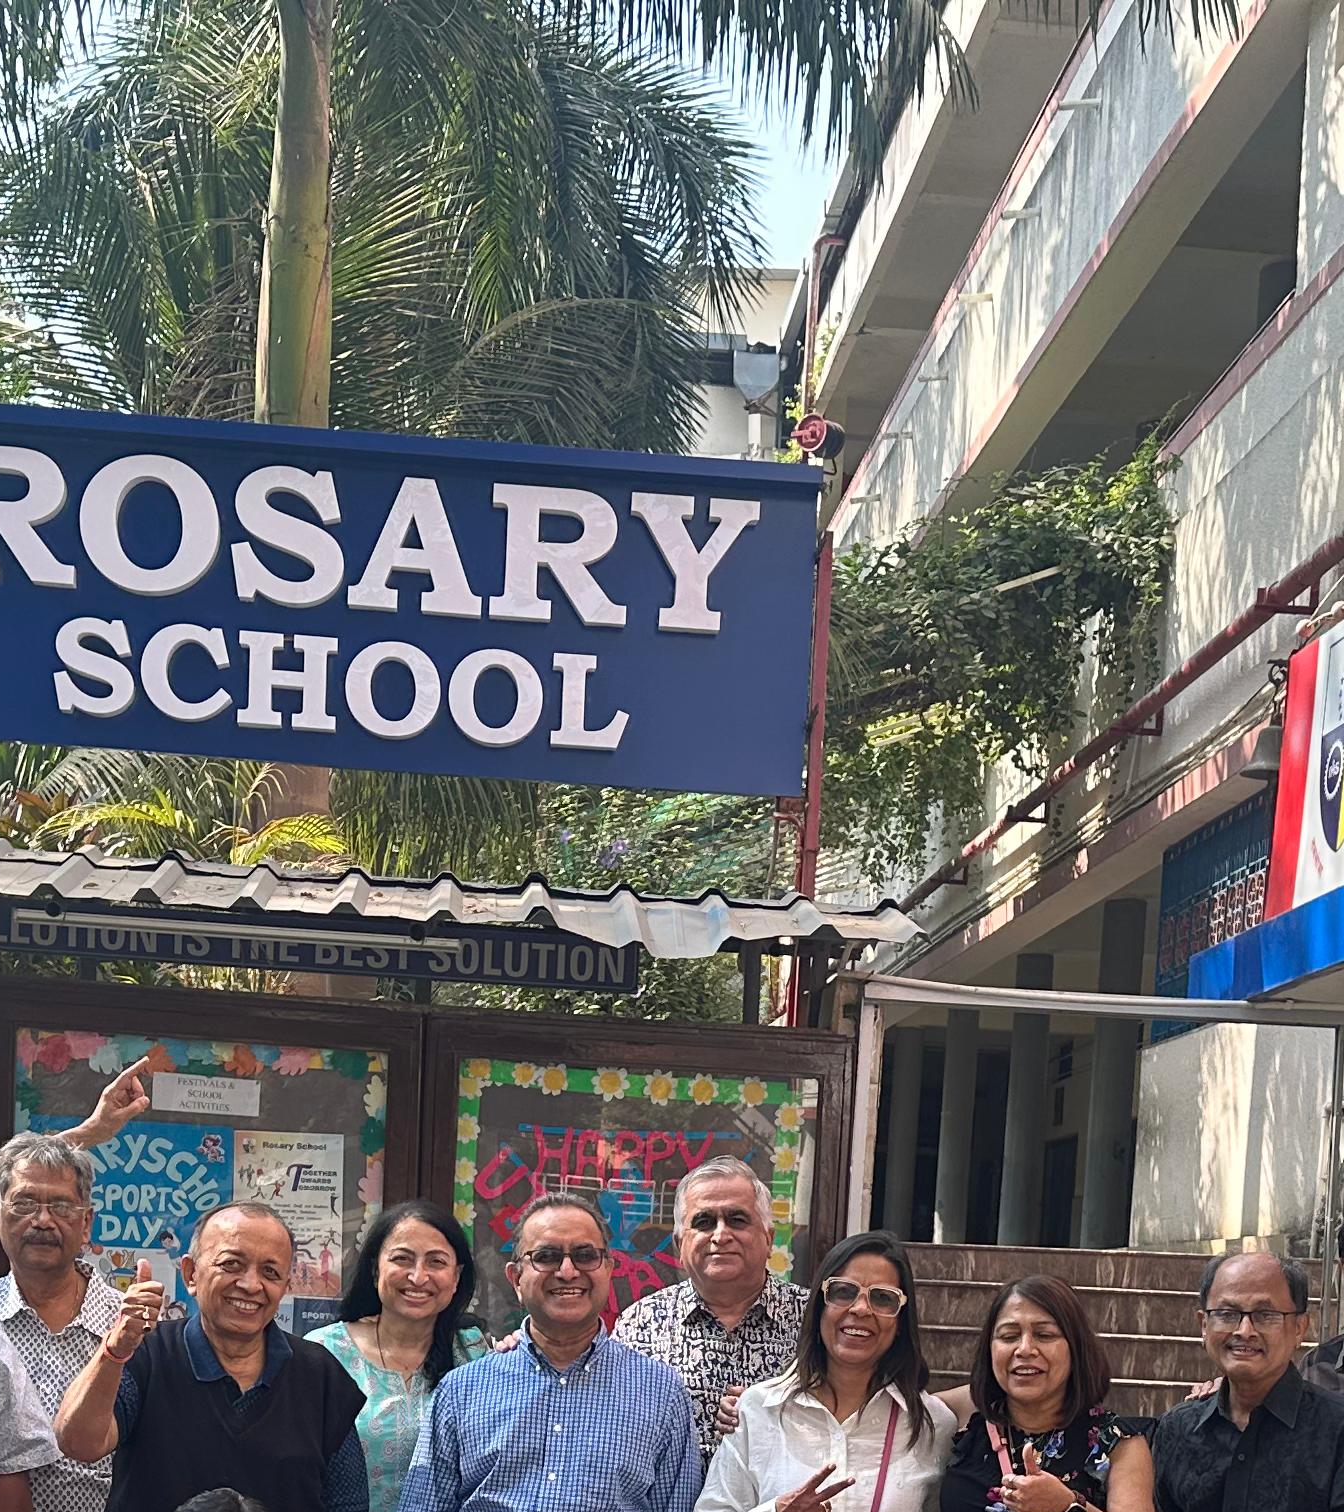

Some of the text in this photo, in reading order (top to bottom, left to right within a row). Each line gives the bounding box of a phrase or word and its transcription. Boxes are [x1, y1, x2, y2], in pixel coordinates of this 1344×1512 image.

[53, 616, 630, 752] SCHOOL
[173, 931, 209, 958] IS
[230, 937, 302, 966] THE
[314, 942, 410, 971] BEST
[428, 940, 627, 984] SOLUTION
[177, 1076, 236, 1089] FESTIVALS &
[187, 1089, 223, 1100] SCHOOL
[262, 1141, 327, 1151] Rosary School
[533, 1124, 716, 1189] HAPPY
[91, 1184, 189, 1217] SPORTS
[98, 1213, 163, 1248] DAY
